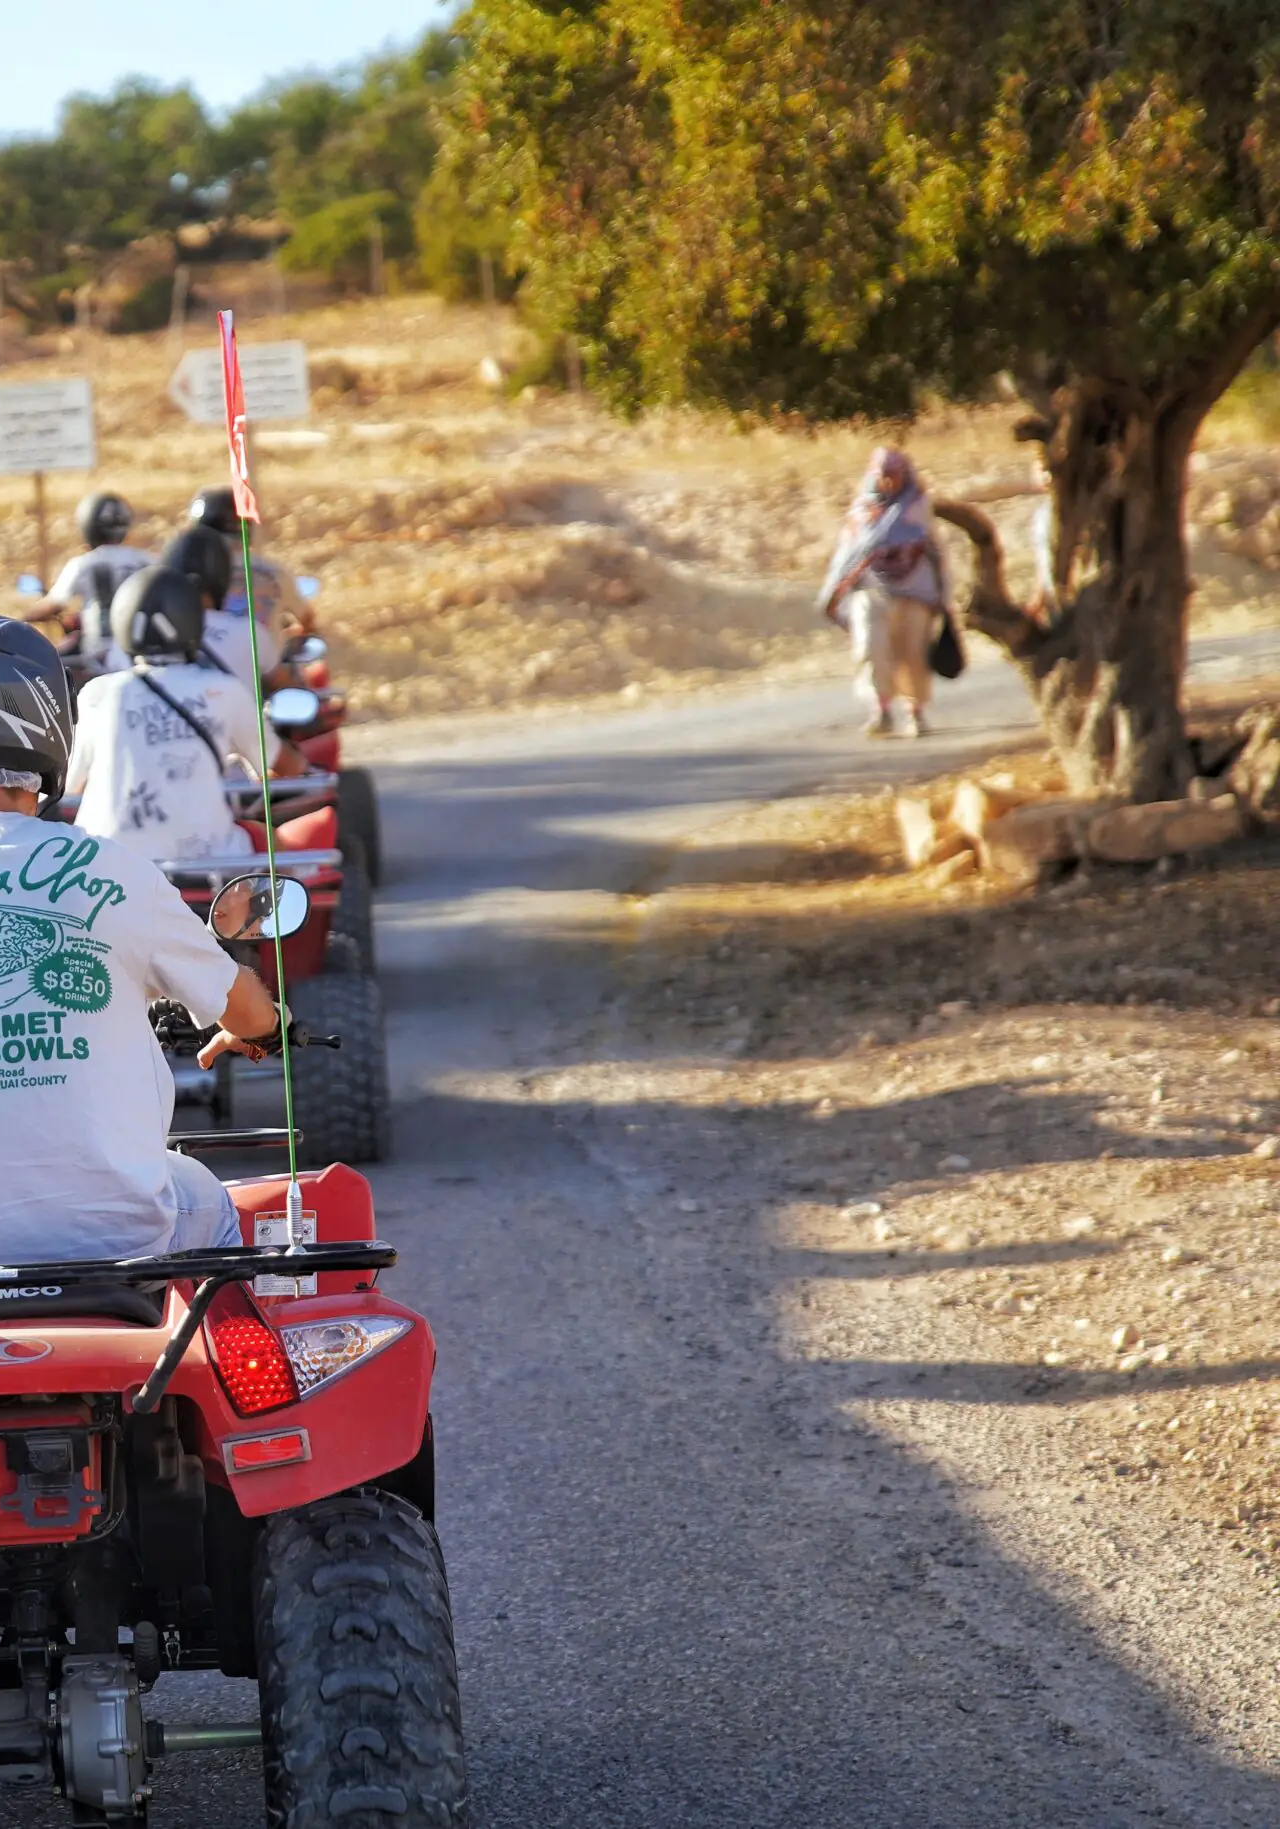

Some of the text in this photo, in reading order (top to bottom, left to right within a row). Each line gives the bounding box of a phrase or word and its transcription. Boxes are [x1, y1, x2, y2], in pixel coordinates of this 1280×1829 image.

[35, 676, 61, 714] URBAN
[18, 836, 128, 932] Chop
[63, 957, 94, 969] Special
[69, 966, 88, 974] offer
[42, 969, 106, 997] $8.50
[65, 993, 91, 1003] DRINK
[0, 1067, 26, 1079] Road
[21, 1074, 68, 1089] COUNTY
